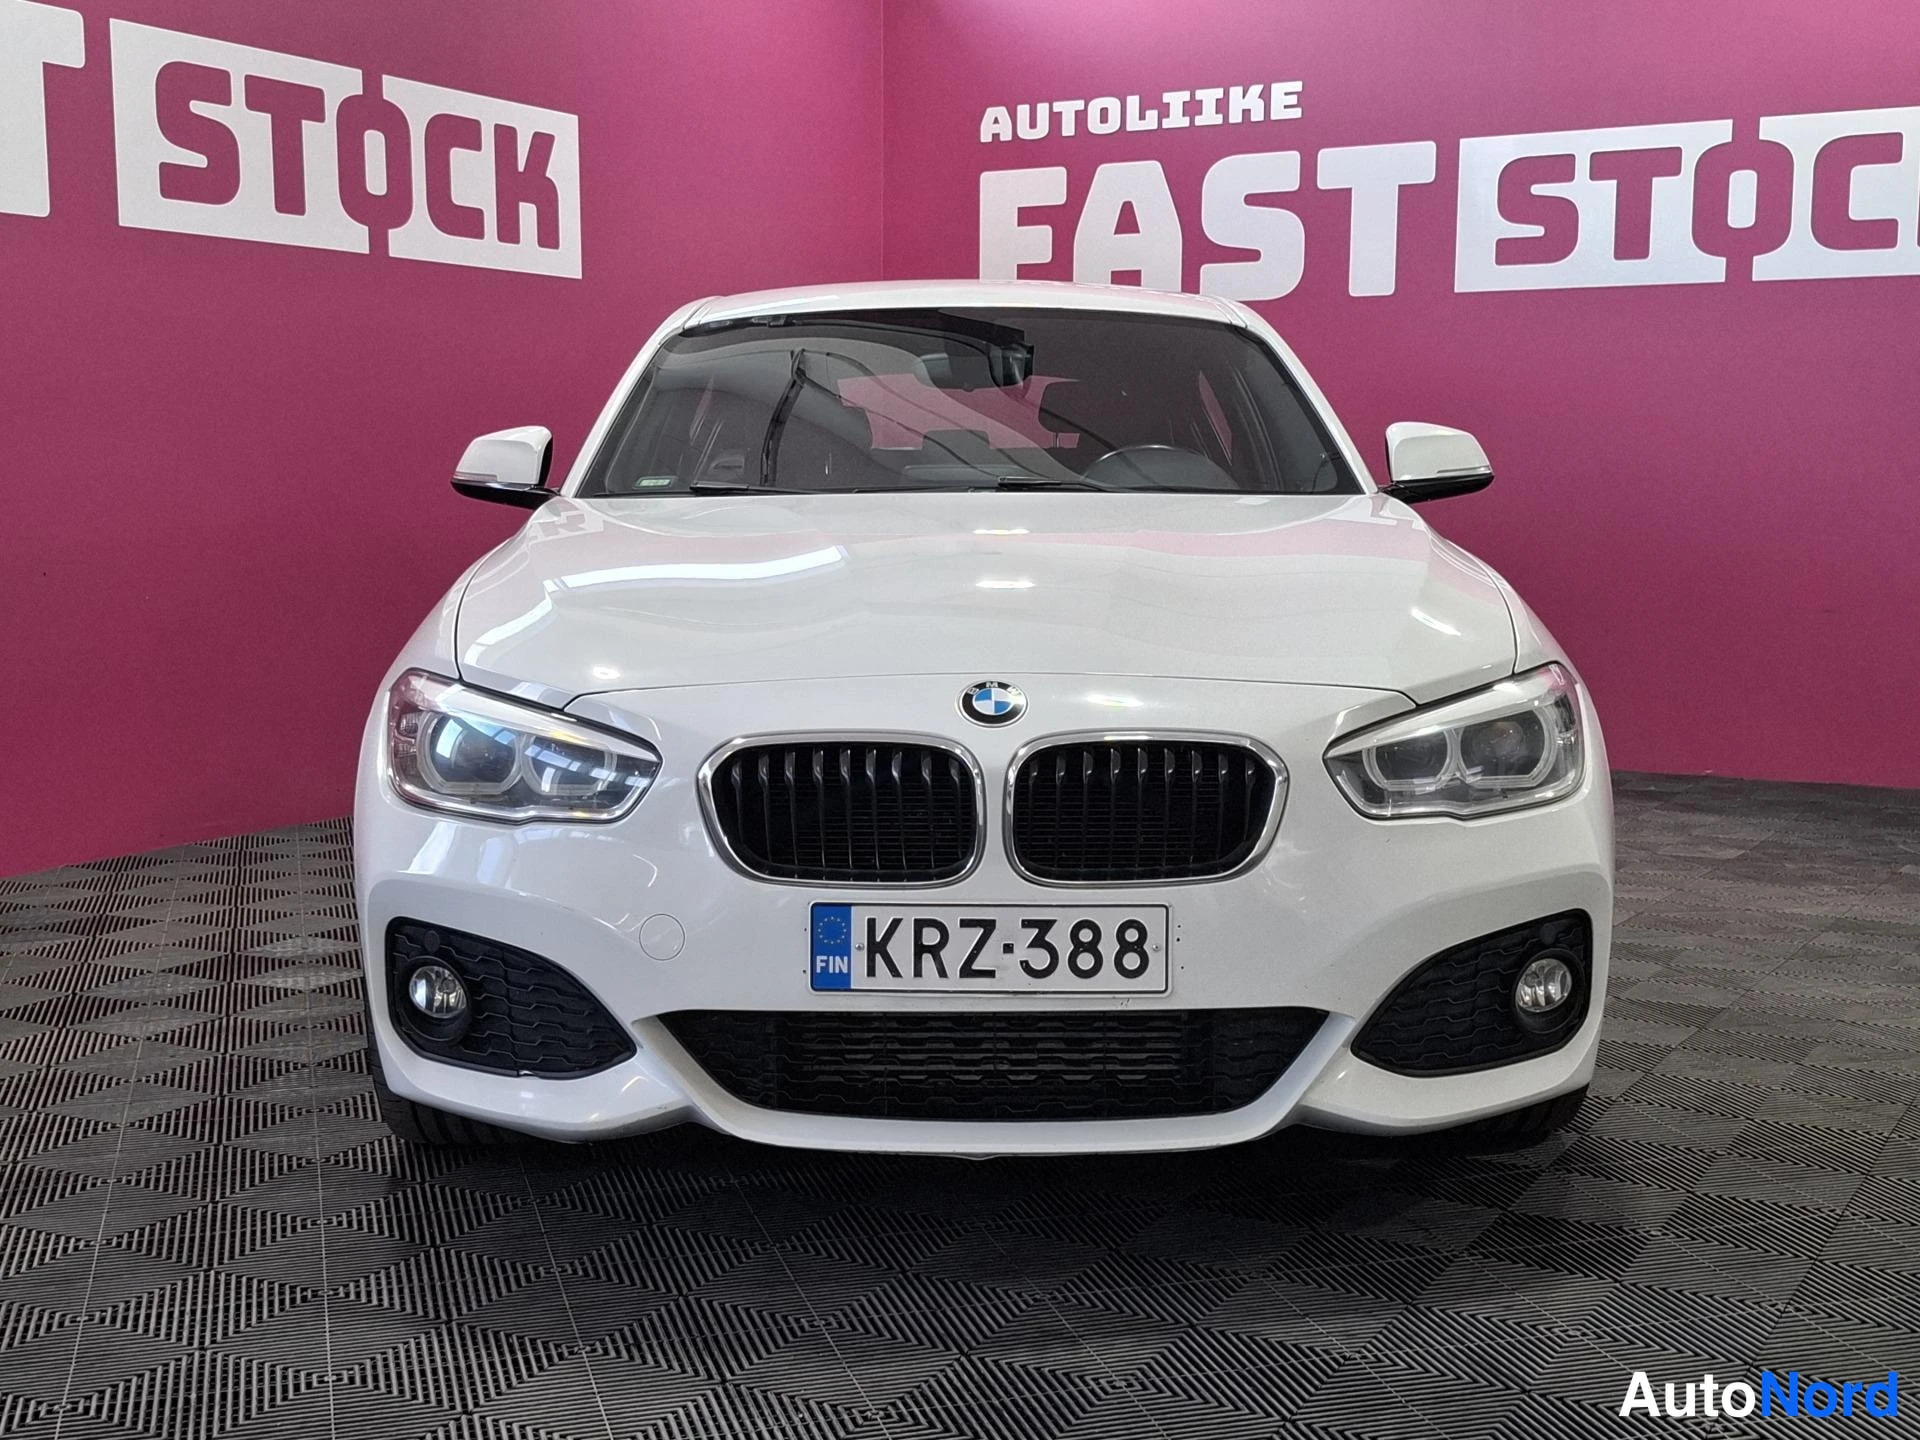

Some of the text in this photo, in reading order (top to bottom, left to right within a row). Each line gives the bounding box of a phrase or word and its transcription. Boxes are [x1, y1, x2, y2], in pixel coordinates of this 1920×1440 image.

[980, 81, 1303, 142] AUTOLIIKE
[154, 60, 560, 252] STOCK
[980, 131, 1920, 300] FAST STOC
[966, 681, 1022, 696] BMW
[815, 918, 1150, 979] FIN KRZ-388
